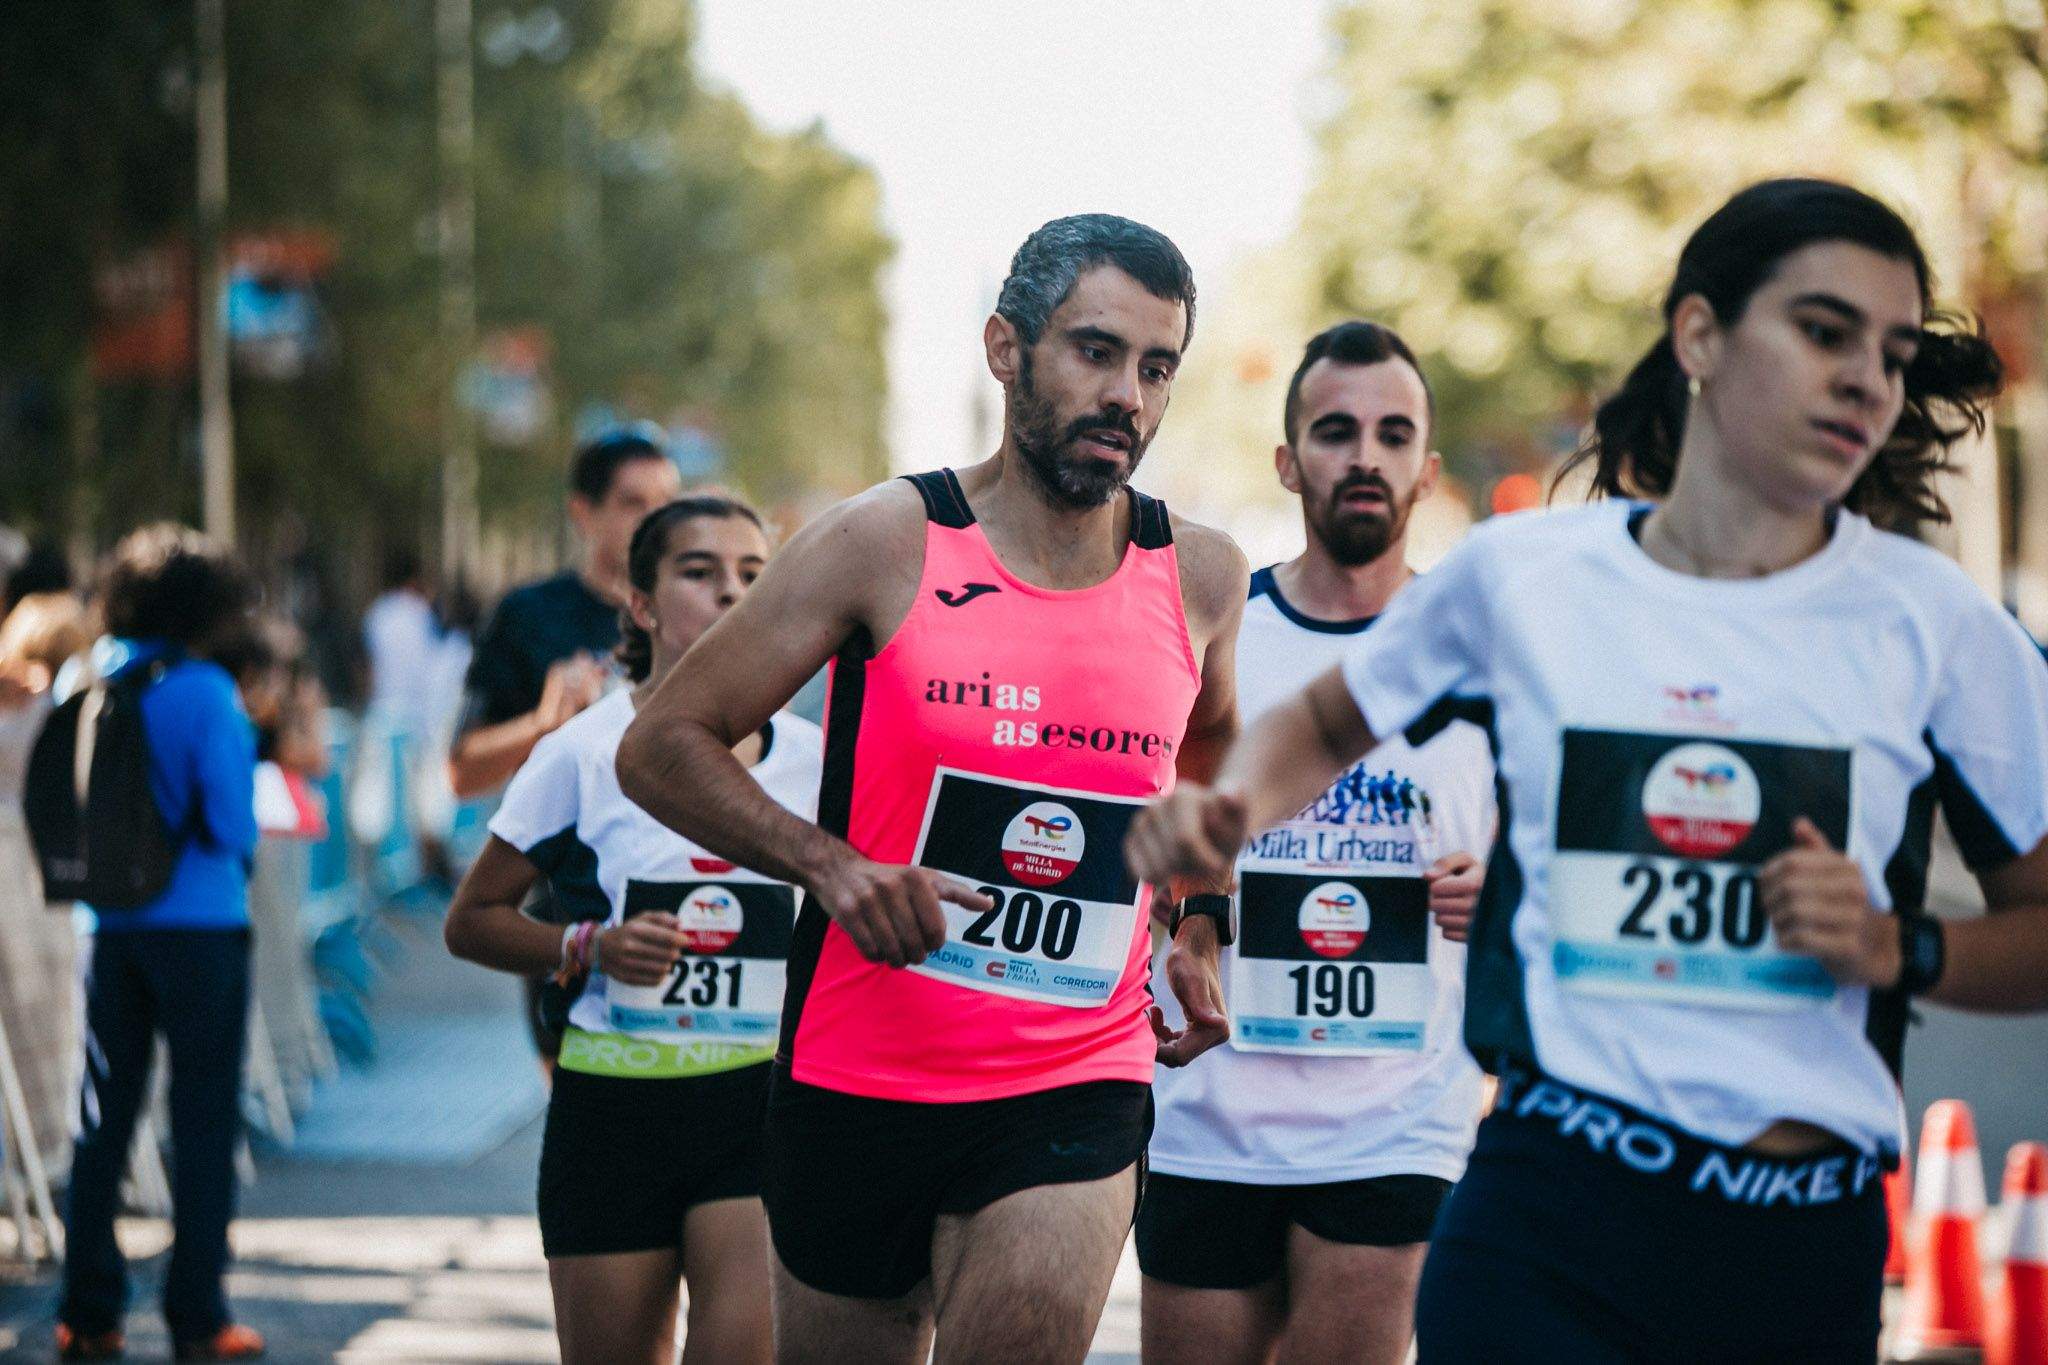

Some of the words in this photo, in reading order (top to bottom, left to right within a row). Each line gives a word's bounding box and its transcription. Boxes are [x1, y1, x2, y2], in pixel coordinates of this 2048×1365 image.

[925, 672, 1041, 711] arias
[992, 719, 1174, 758] asesores
[1025, 854, 1053, 867] MILLA
[1318, 830, 1414, 863] Urbana
[1012, 862, 1025, 872] DE
[1026, 865, 1062, 878] MADRID
[962, 885, 1082, 961] 200
[1619, 865, 1767, 951] 230
[663, 959, 743, 1008] 231
[1288, 964, 1375, 1018] 190
[568, 1035, 659, 1069] PRO
[1516, 1081, 1677, 1173] PRO
[1690, 1151, 1847, 1206] NIKE
